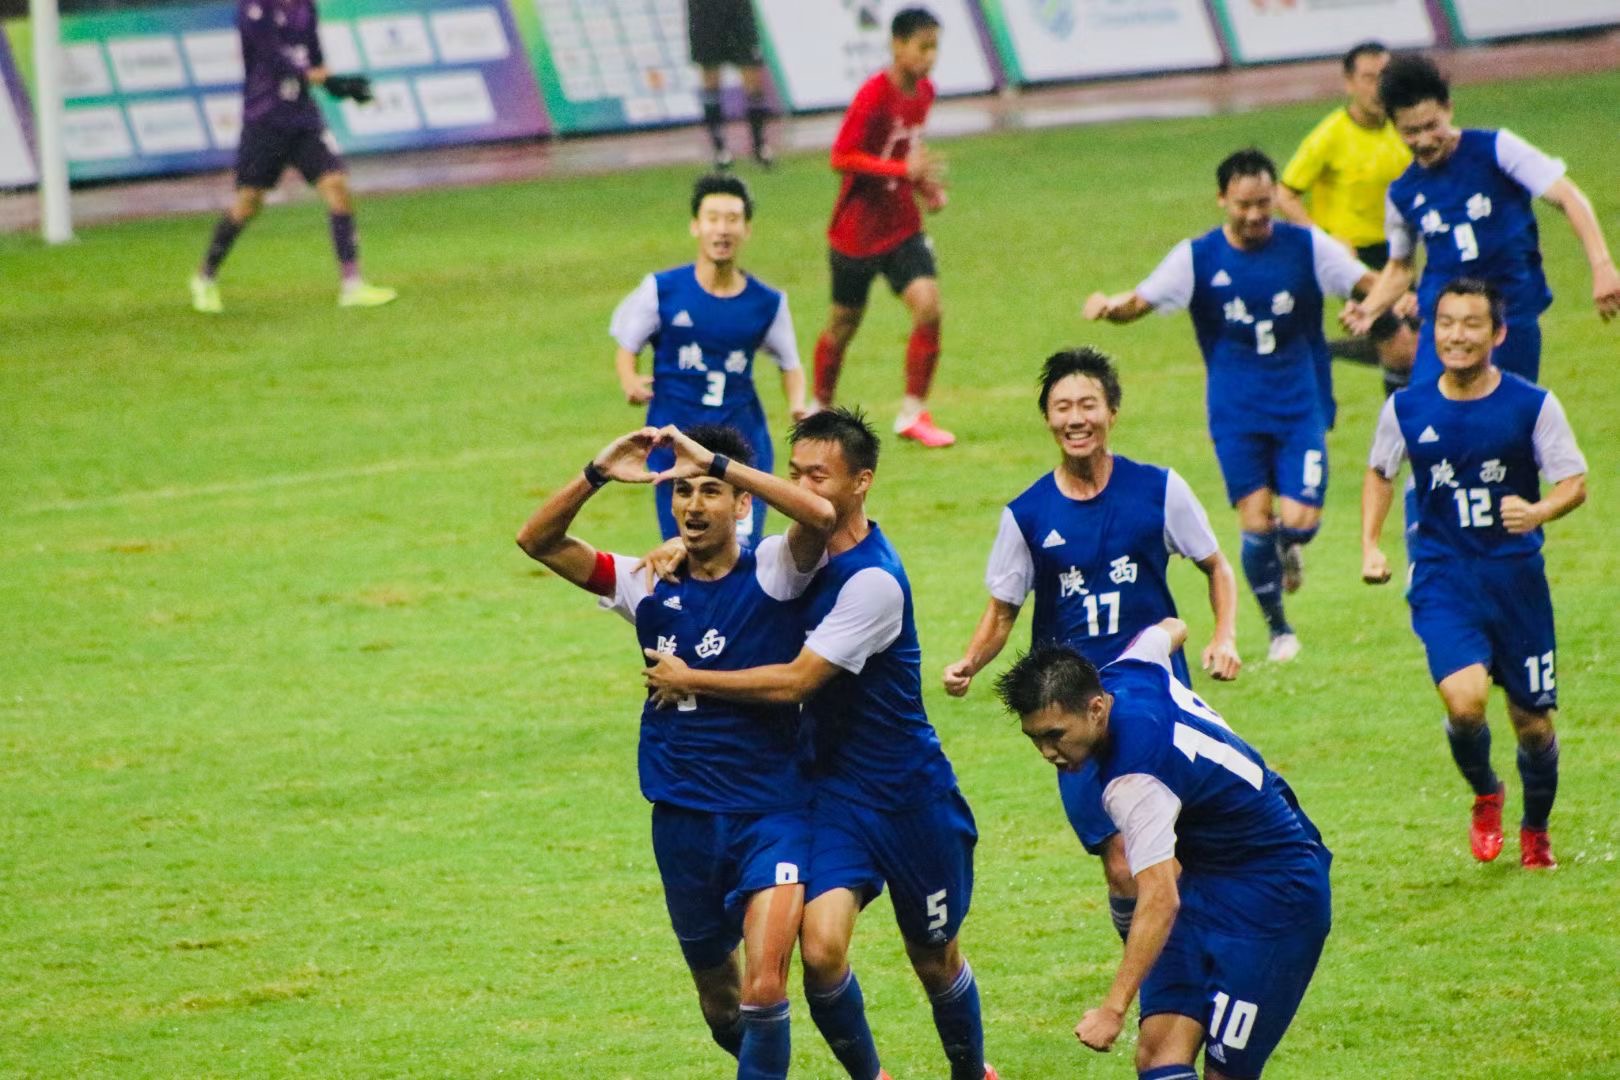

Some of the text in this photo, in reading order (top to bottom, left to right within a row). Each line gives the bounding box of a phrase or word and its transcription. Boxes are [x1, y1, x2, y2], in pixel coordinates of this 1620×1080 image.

[1453, 222, 1479, 262] 9
[701, 370, 726, 407] 3
[1303, 449, 1322, 487] 6
[1453, 487, 1494, 528] 12
[1059, 554, 1138, 598] 陕西
[1082, 591, 1120, 637] 17
[1524, 649, 1556, 693] 12
[926, 887, 948, 931] 5
[1209, 991, 1259, 1050] 10
